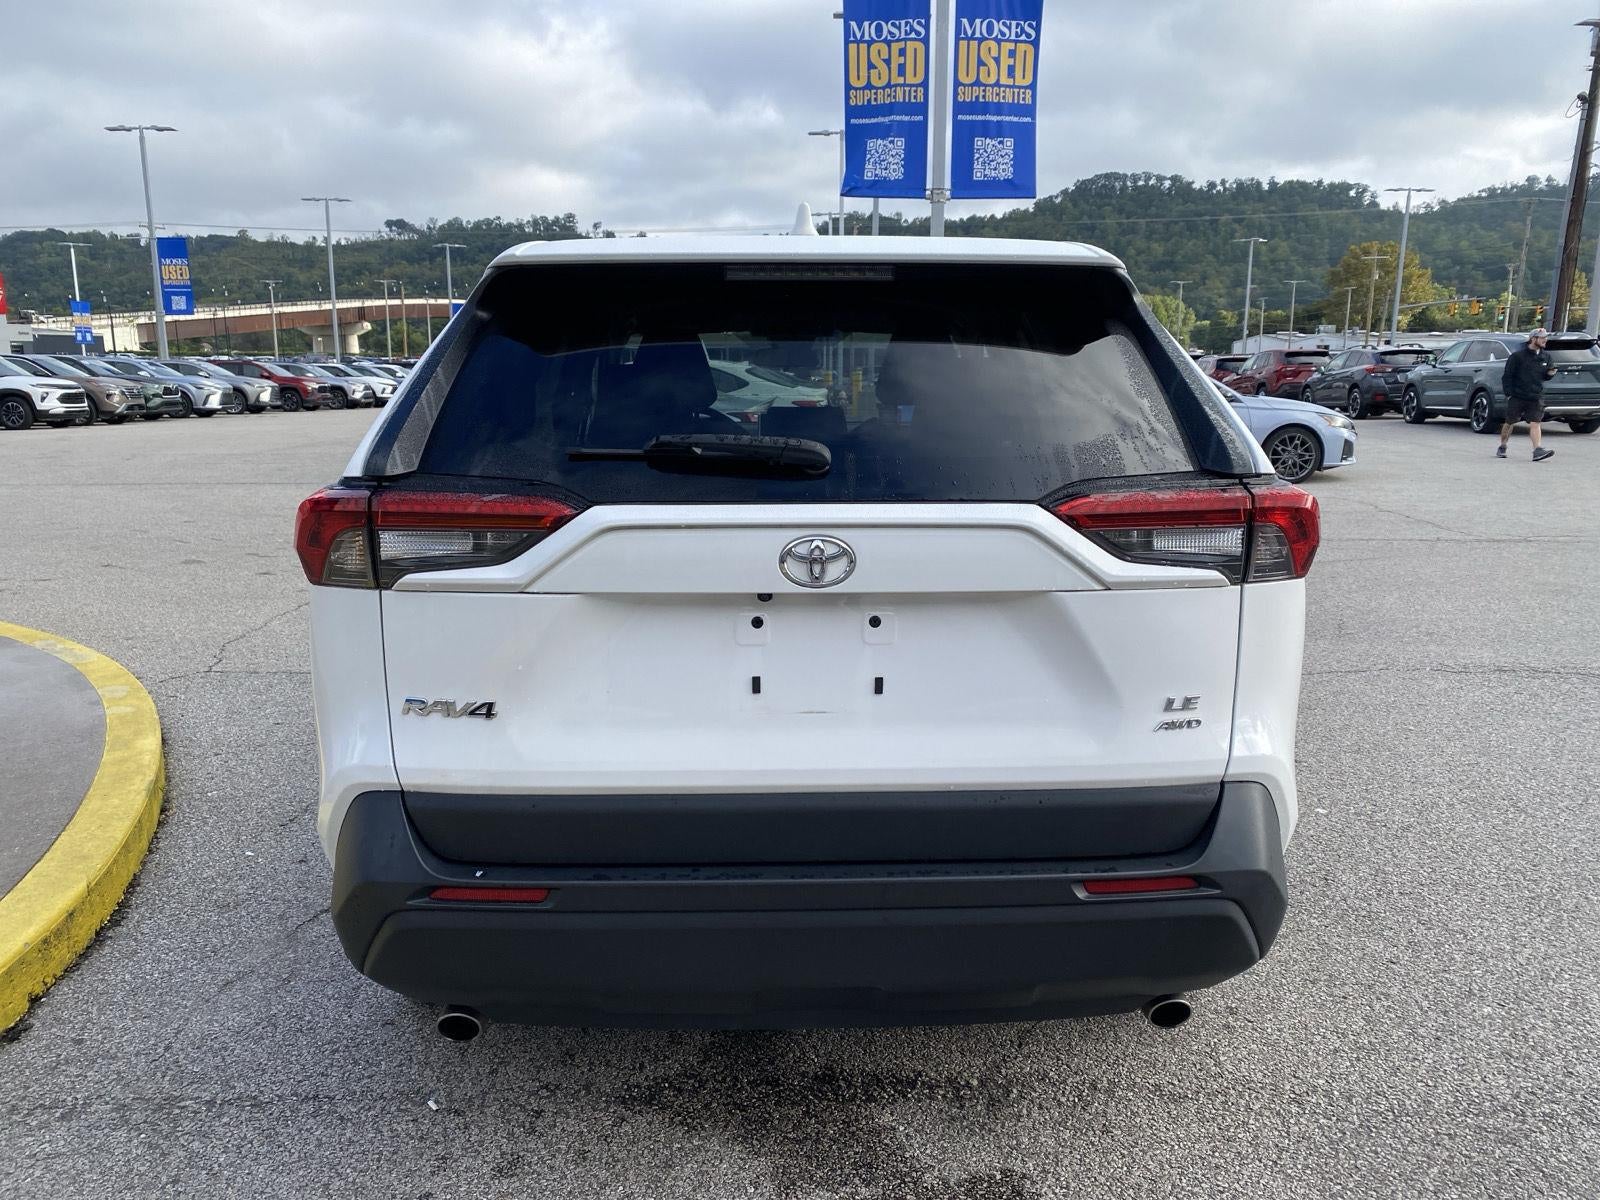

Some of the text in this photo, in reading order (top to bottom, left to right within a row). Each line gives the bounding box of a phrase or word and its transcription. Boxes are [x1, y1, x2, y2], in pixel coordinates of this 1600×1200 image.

[850, 18, 925, 41] MOSES
[960, 18, 1037, 41] MOSES
[848, 41, 925, 87] USED
[957, 40, 1035, 86] USED
[849, 87, 924, 106] SUPERCENTER
[957, 86, 1032, 105] SUPERCENTER
[161, 257, 188, 265] MOSES
[162, 265, 190, 280] USED
[402, 697, 498, 720] RAV4
[1163, 695, 1201, 712] LE
[1153, 718, 1202, 733] AWD
